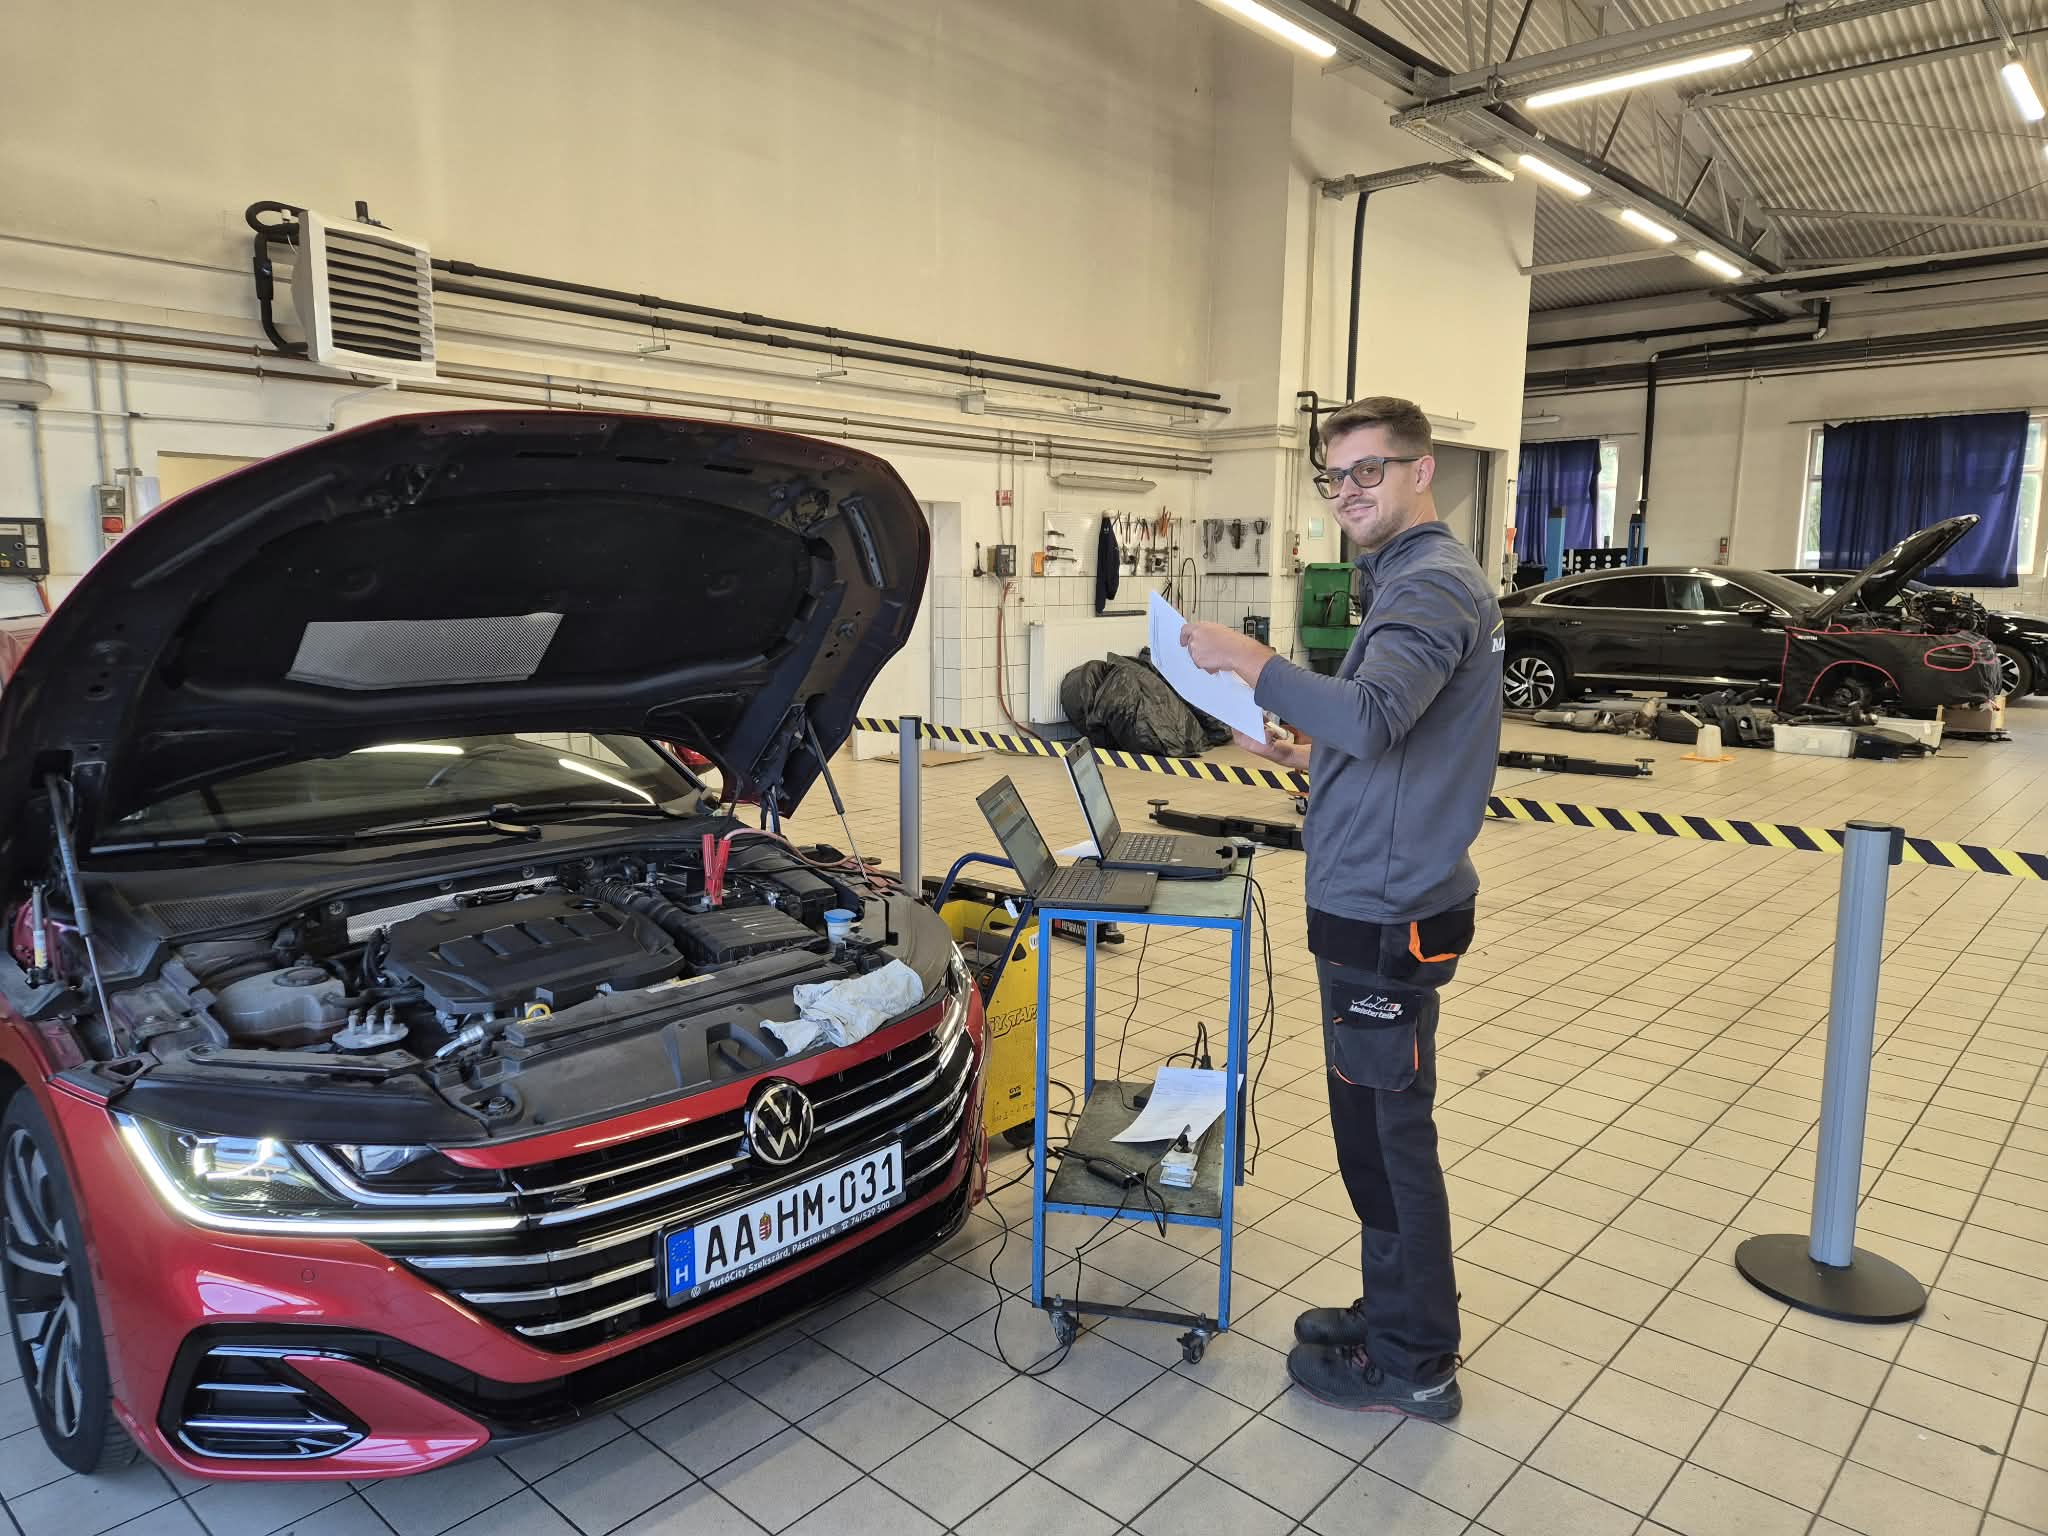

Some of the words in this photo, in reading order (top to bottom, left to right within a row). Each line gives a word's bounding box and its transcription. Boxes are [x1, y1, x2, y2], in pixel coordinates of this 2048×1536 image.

[705, 1214, 756, 1274] AA
[777, 1152, 896, 1244] HM-031
[676, 1264, 689, 1286] H
[708, 1266, 747, 1290] AutóCity
[748, 1247, 791, 1273] Szekszárd,
[792, 1234, 821, 1253] Pásztor
